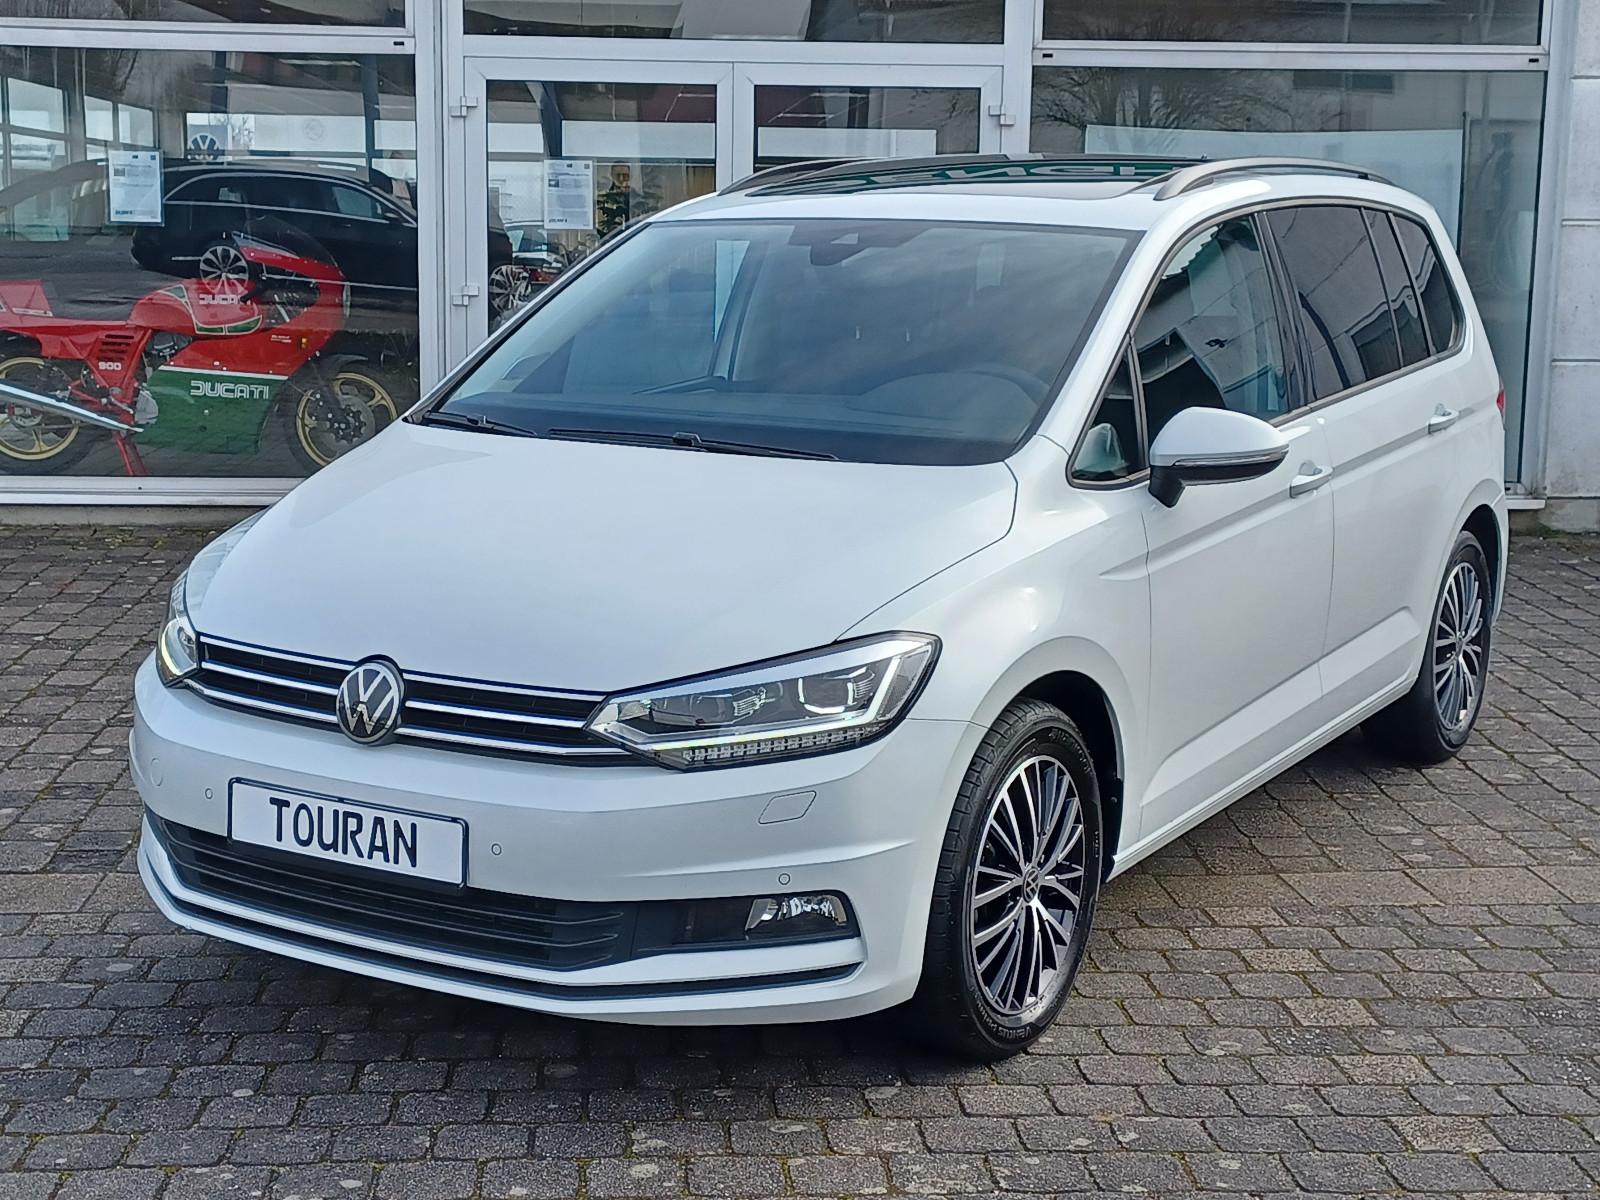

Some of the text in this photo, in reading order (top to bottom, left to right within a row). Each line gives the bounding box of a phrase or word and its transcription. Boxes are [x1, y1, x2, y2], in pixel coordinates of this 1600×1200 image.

[199, 294, 251, 305] DUCA
[98, 361, 121, 371] 900
[190, 380, 270, 400] DUCATI
[269, 796, 418, 868] TOURAN
